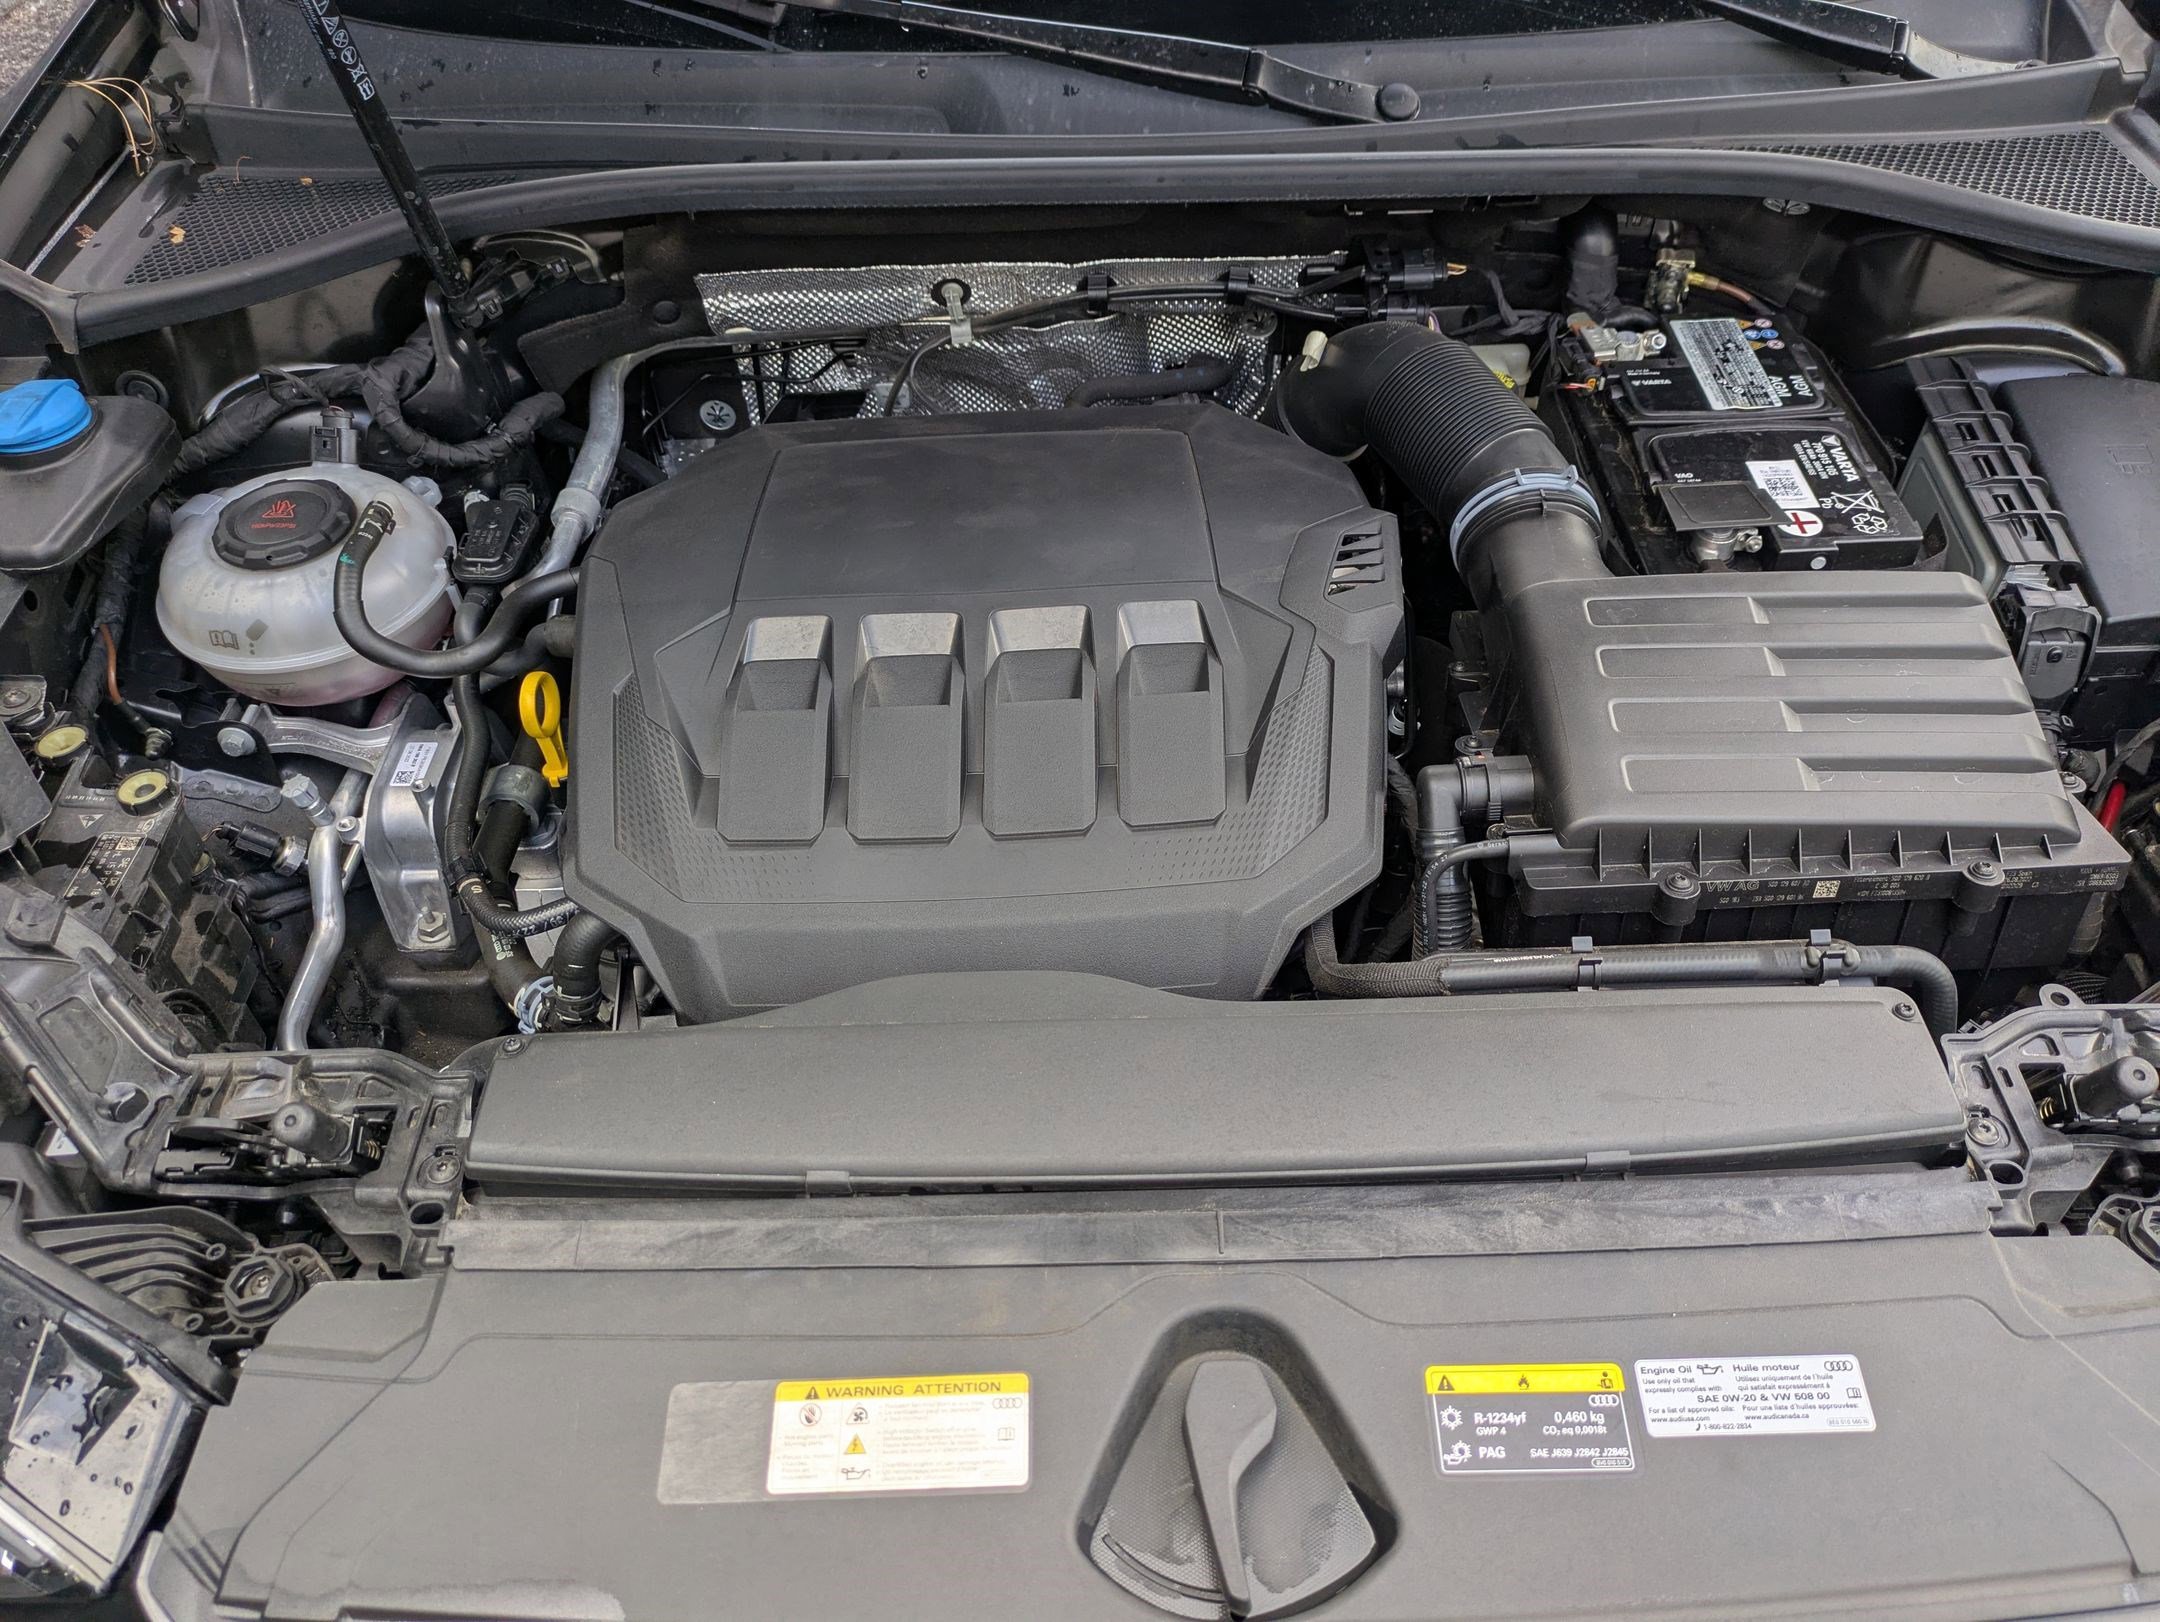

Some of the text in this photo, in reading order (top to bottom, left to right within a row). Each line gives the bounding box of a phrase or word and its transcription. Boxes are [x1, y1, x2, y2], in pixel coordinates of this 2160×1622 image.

[1769, 375, 1792, 397] AGM
[1789, 374, 1813, 397] AGM
[1830, 447, 1860, 482] VARTA
[1819, 498, 1834, 509] Pb
[1706, 880, 1760, 892] VW AG
[1640, 1364, 1693, 1376] Engine Oil
[1732, 1363, 1800, 1372] Huile moteur
[1657, 1377, 1672, 1385] only
[1682, 1376, 1695, 1384] that
[1735, 1373, 1834, 1383] Utilisez uniquement de l'huile
[826, 1382, 1002, 1398] WARNING ATTENTION
[1645, 1386, 1676, 1394] expressly
[1677, 1385, 1706, 1393] complies
[1737, 1384, 1748, 1392] qui
[1750, 1383, 1777, 1391] satisfait
[1778, 1382, 1824, 1391] expressément
[1697, 1392, 1831, 1403] SAE 0W-20 & VW 508 00
[1648, 1406, 1660, 1414] For
[1679, 1405, 1687, 1413] of
[1687, 1405, 1718, 1414] approved
[1742, 1404, 1758, 1412] Pour
[1788, 1403, 1817, 1411] d'huiles
[1474, 1411, 1527, 1426] R-1234yf
[1554, 1411, 1605, 1425] 0,460 kg
[1651, 1415, 1711, 1423] www.audiusa.com
[1744, 1412, 1810, 1421] www.audicanada.ca
[1476, 1426, 1507, 1436] GWP 4
[1561, 1427, 1574, 1436] eq
[1478, 1446, 1506, 1458] PAG
[1530, 1447, 1629, 1458] SAE J639 J2842 J2845
